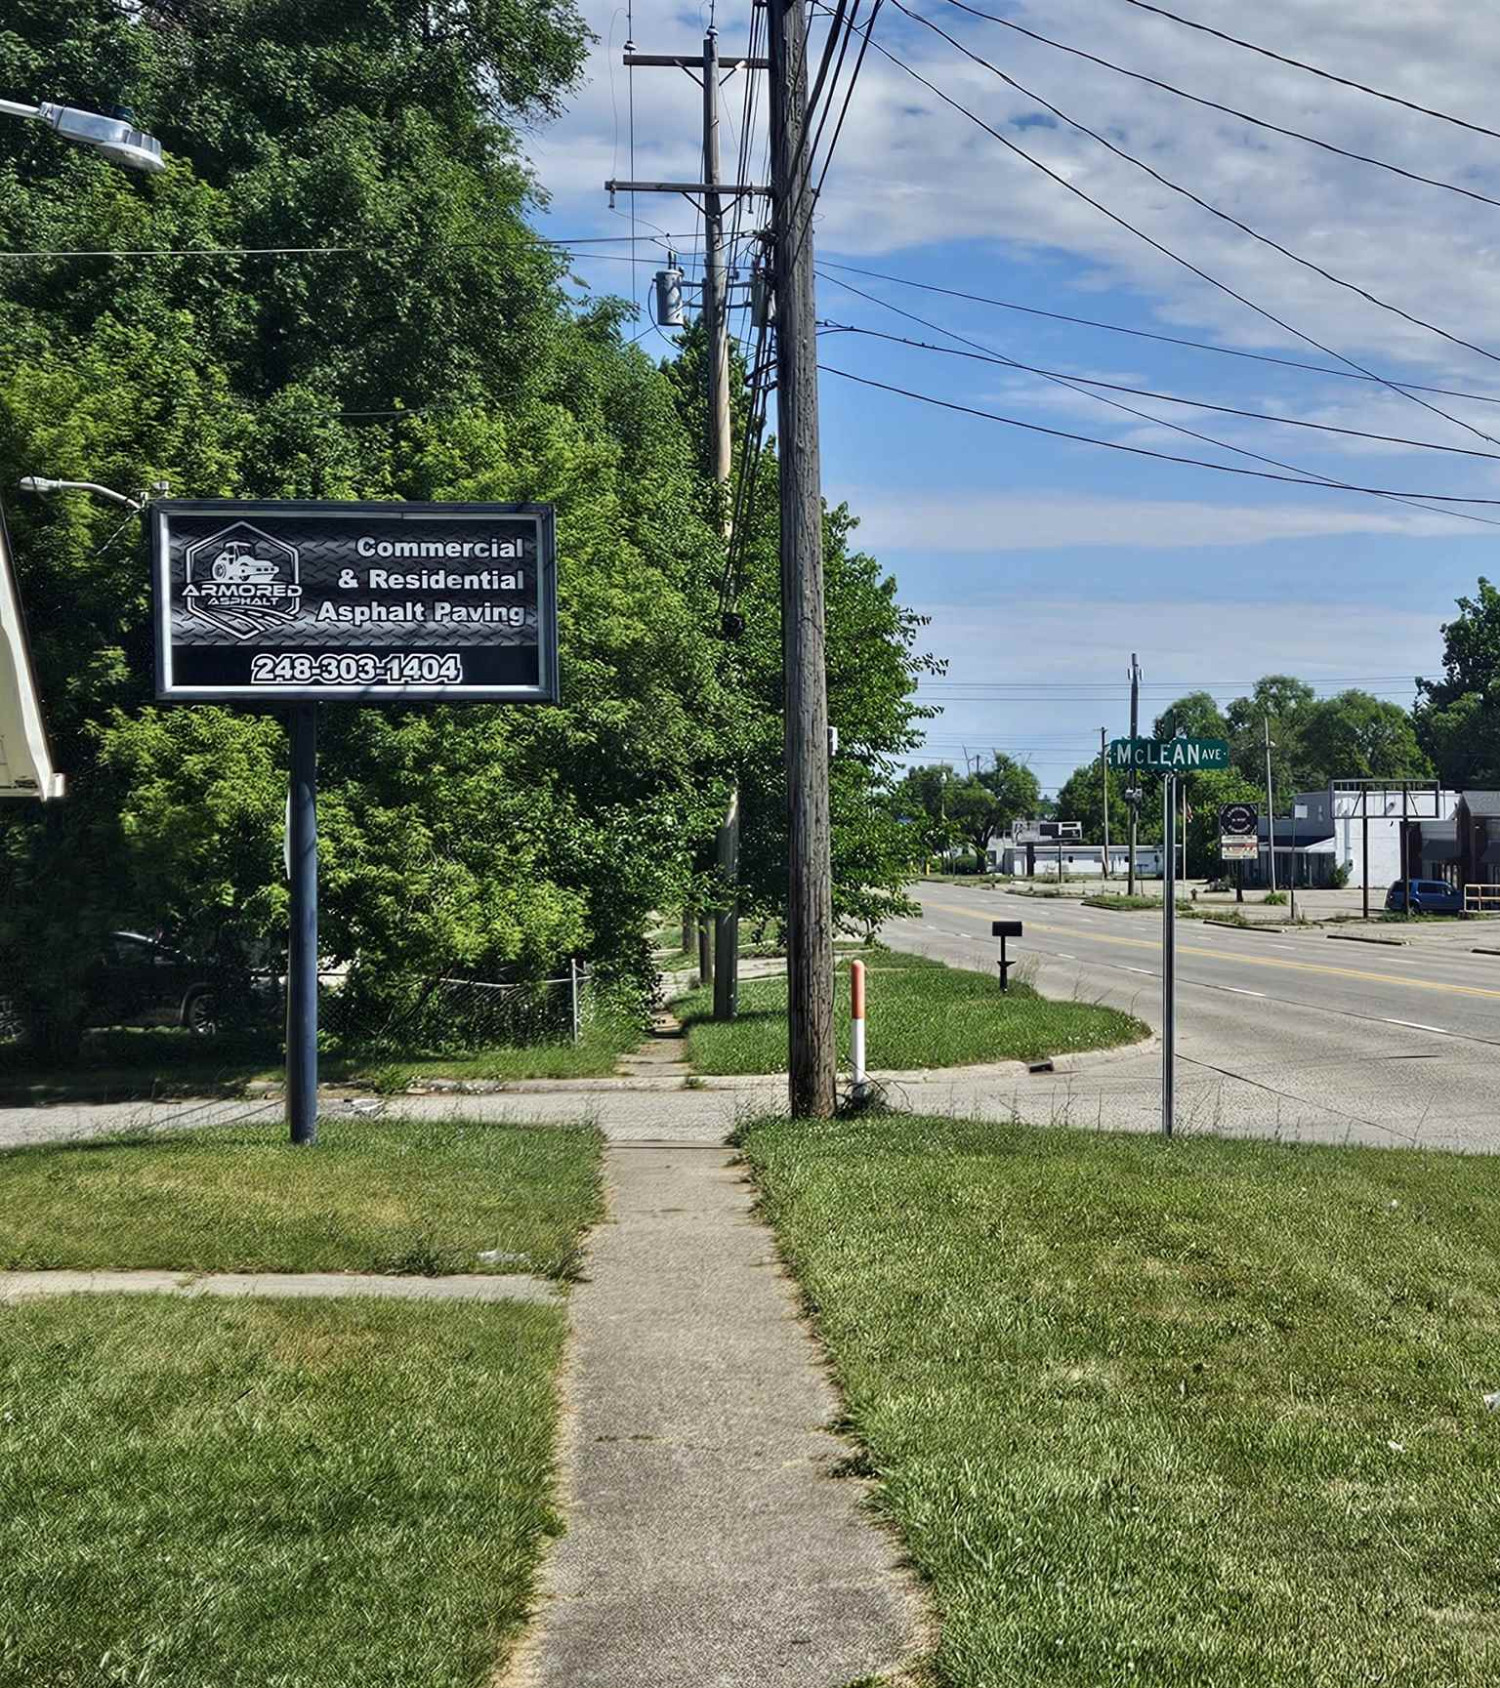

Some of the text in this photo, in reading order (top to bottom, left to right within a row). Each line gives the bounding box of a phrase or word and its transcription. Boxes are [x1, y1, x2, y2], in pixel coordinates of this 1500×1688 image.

[356, 537, 524, 558] Commercial
[182, 583, 302, 597] ARMORED
[337, 569, 524, 590] & Residential
[207, 597, 279, 606] ASPHALT
[316, 601, 526, 627] Asphalt Paving
[253, 655, 461, 683] 248-303-1404
[1117, 743, 1200, 765] McLEAN
[1201, 748, 1221, 761] AVE
